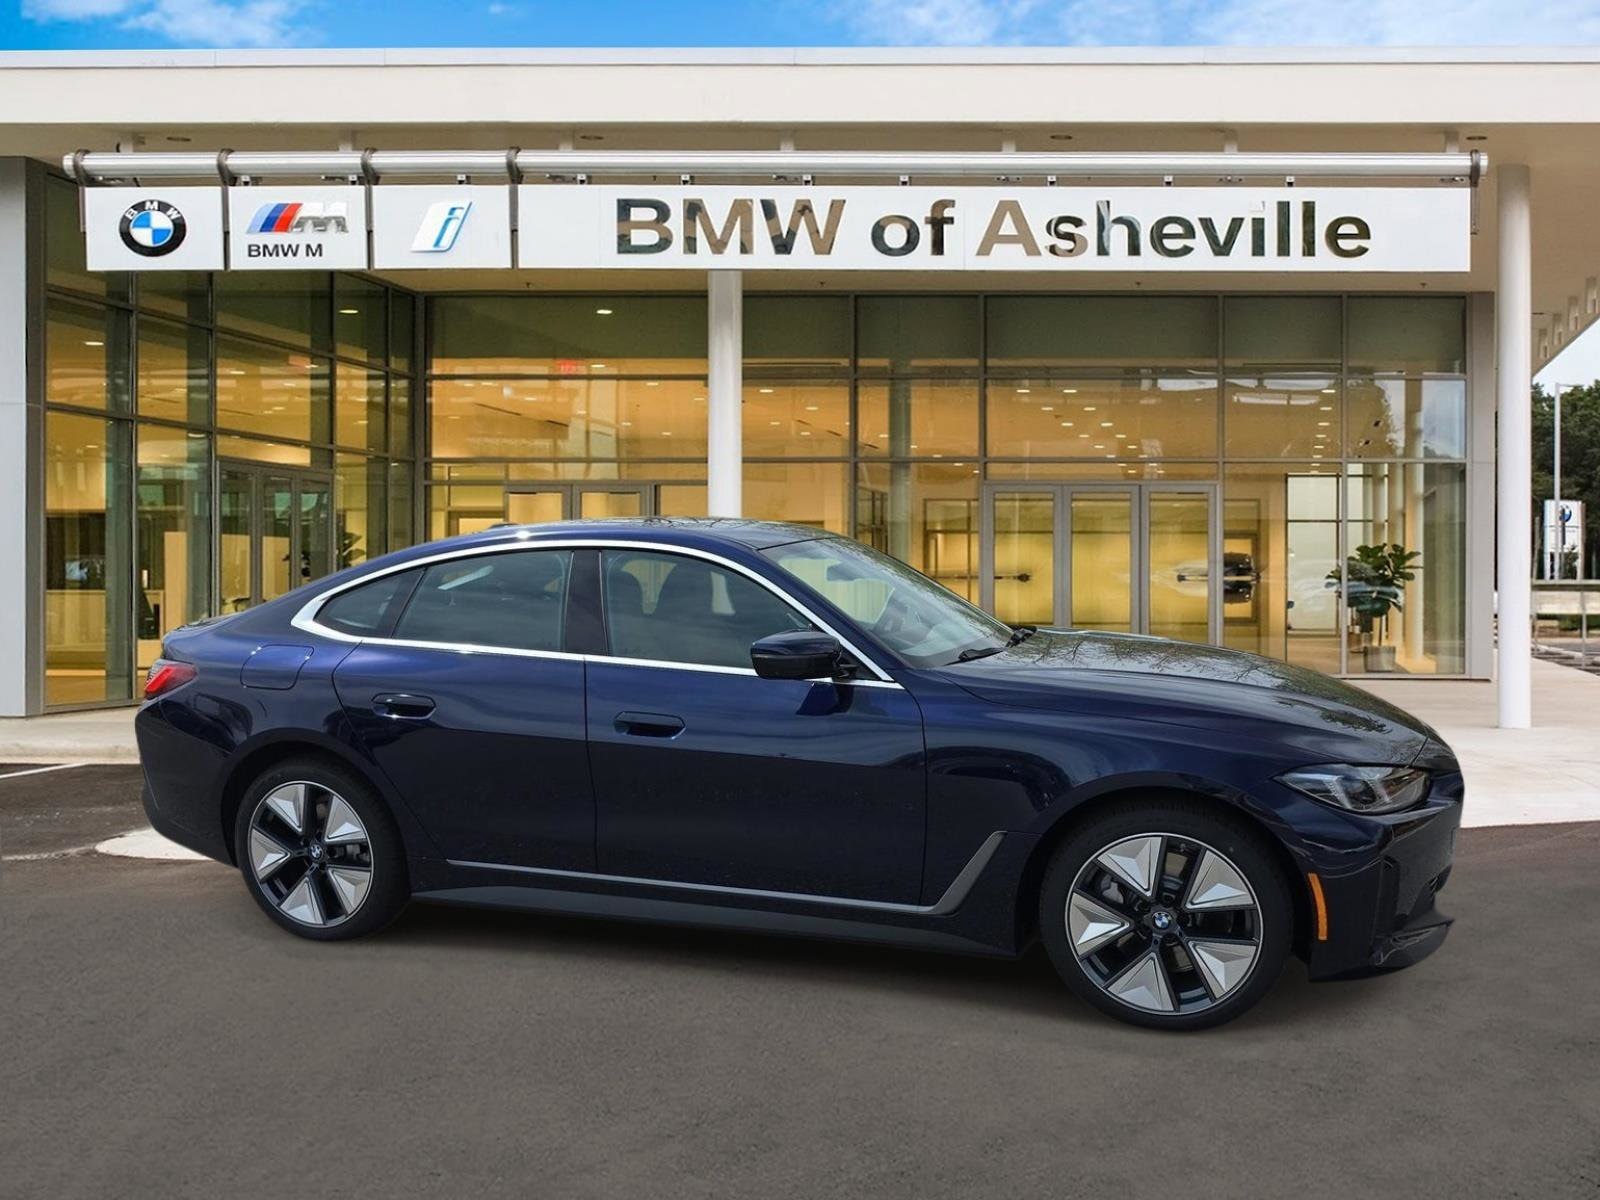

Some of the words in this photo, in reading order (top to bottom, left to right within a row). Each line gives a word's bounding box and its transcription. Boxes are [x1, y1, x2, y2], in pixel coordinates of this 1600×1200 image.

[615, 198, 847, 255] BMW
[870, 199, 956, 257] of
[975, 199, 1372, 258] Asheville
[247, 243, 300, 258] BMW
[305, 243, 323, 258] M
